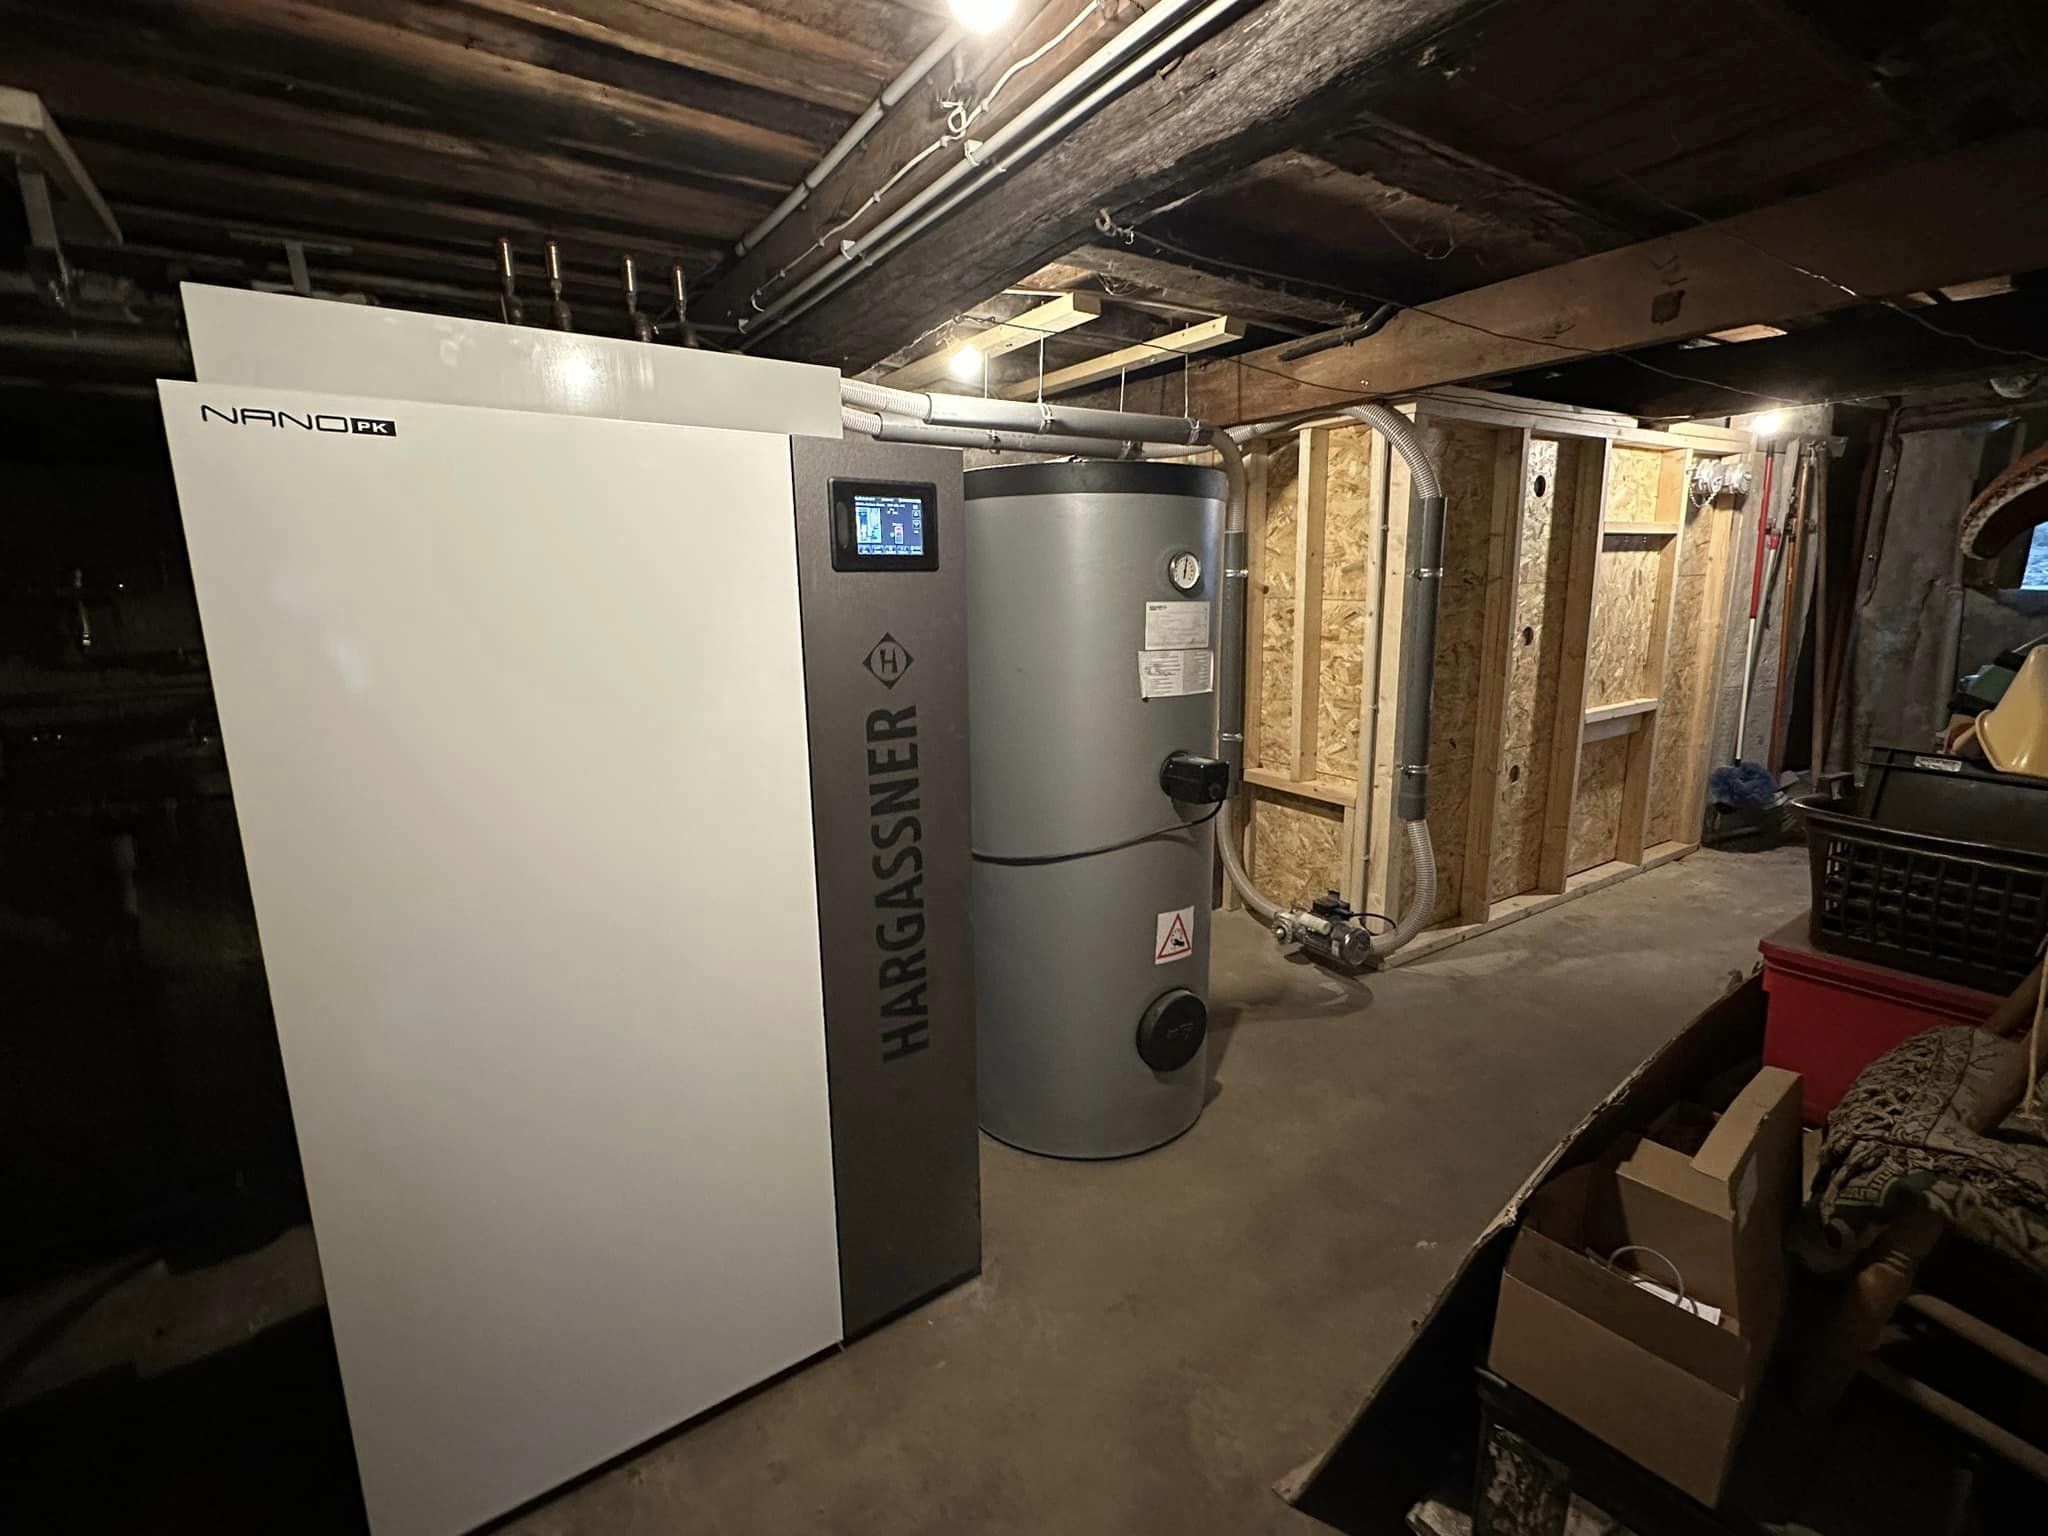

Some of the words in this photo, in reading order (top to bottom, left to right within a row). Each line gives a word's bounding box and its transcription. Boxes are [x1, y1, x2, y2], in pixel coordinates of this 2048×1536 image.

[201, 405, 348, 433] NANO
[356, 420, 390, 435] PK
[866, 704, 930, 1064] HARGASSNER
